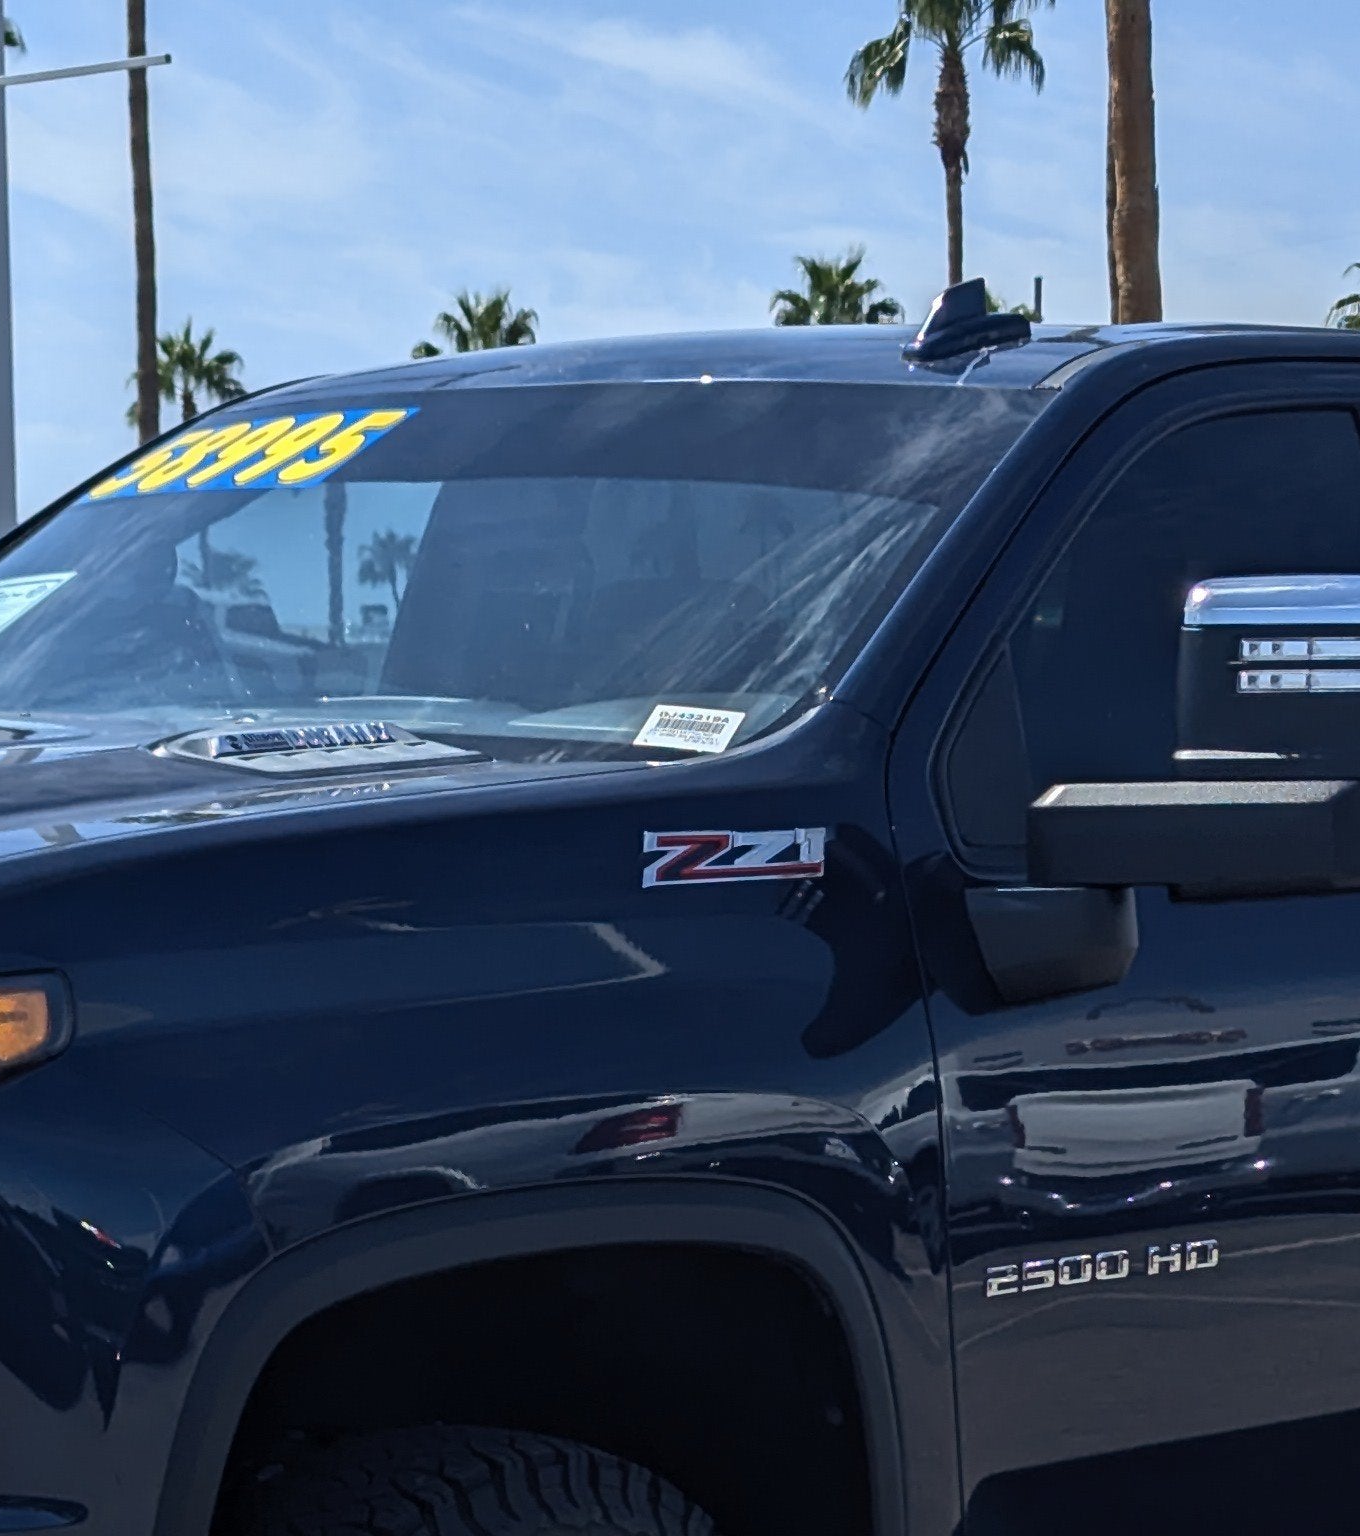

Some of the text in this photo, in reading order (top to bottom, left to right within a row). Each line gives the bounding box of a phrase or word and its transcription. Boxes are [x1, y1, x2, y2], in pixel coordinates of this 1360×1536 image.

[90, 409, 408, 500] 58995
[986, 1238, 1220, 1298] 2500 HD
